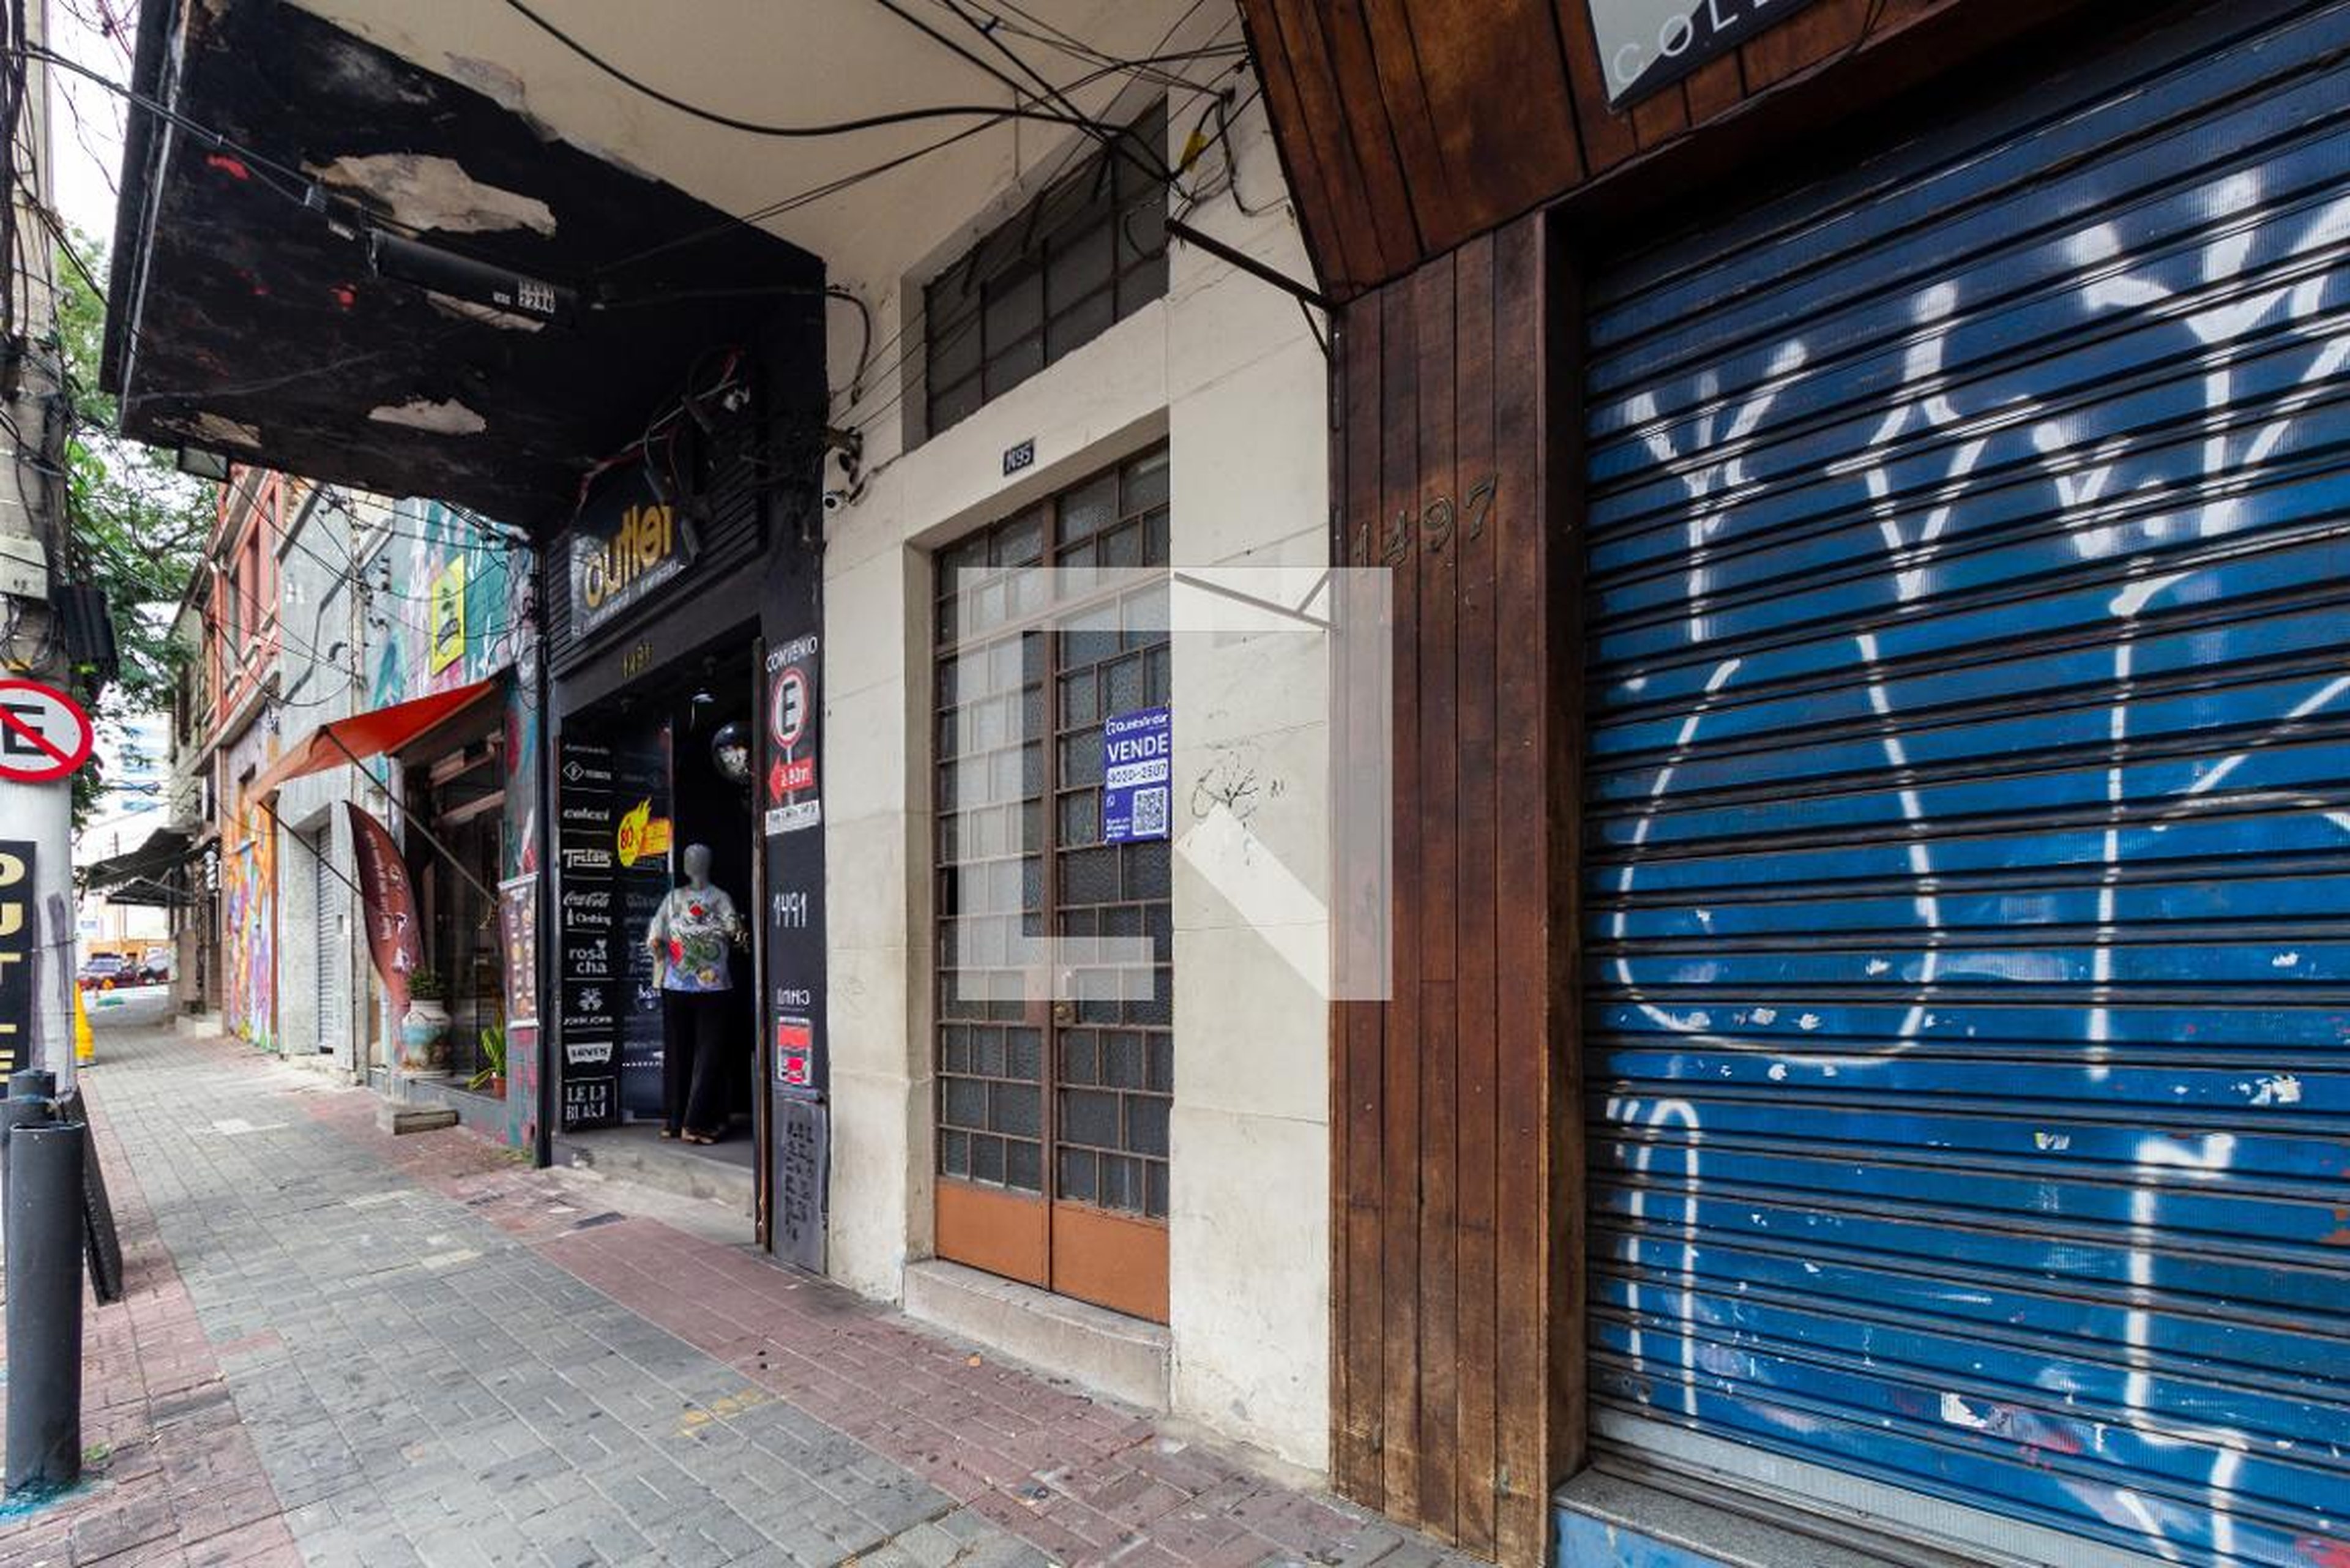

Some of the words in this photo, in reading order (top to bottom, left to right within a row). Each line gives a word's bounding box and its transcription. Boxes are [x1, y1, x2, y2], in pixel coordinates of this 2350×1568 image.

[1613, 0, 1770, 81] COL
[1, 704, 45, 756] E
[783, 681, 796, 735] E
[1108, 733, 1168, 762] VENDE
